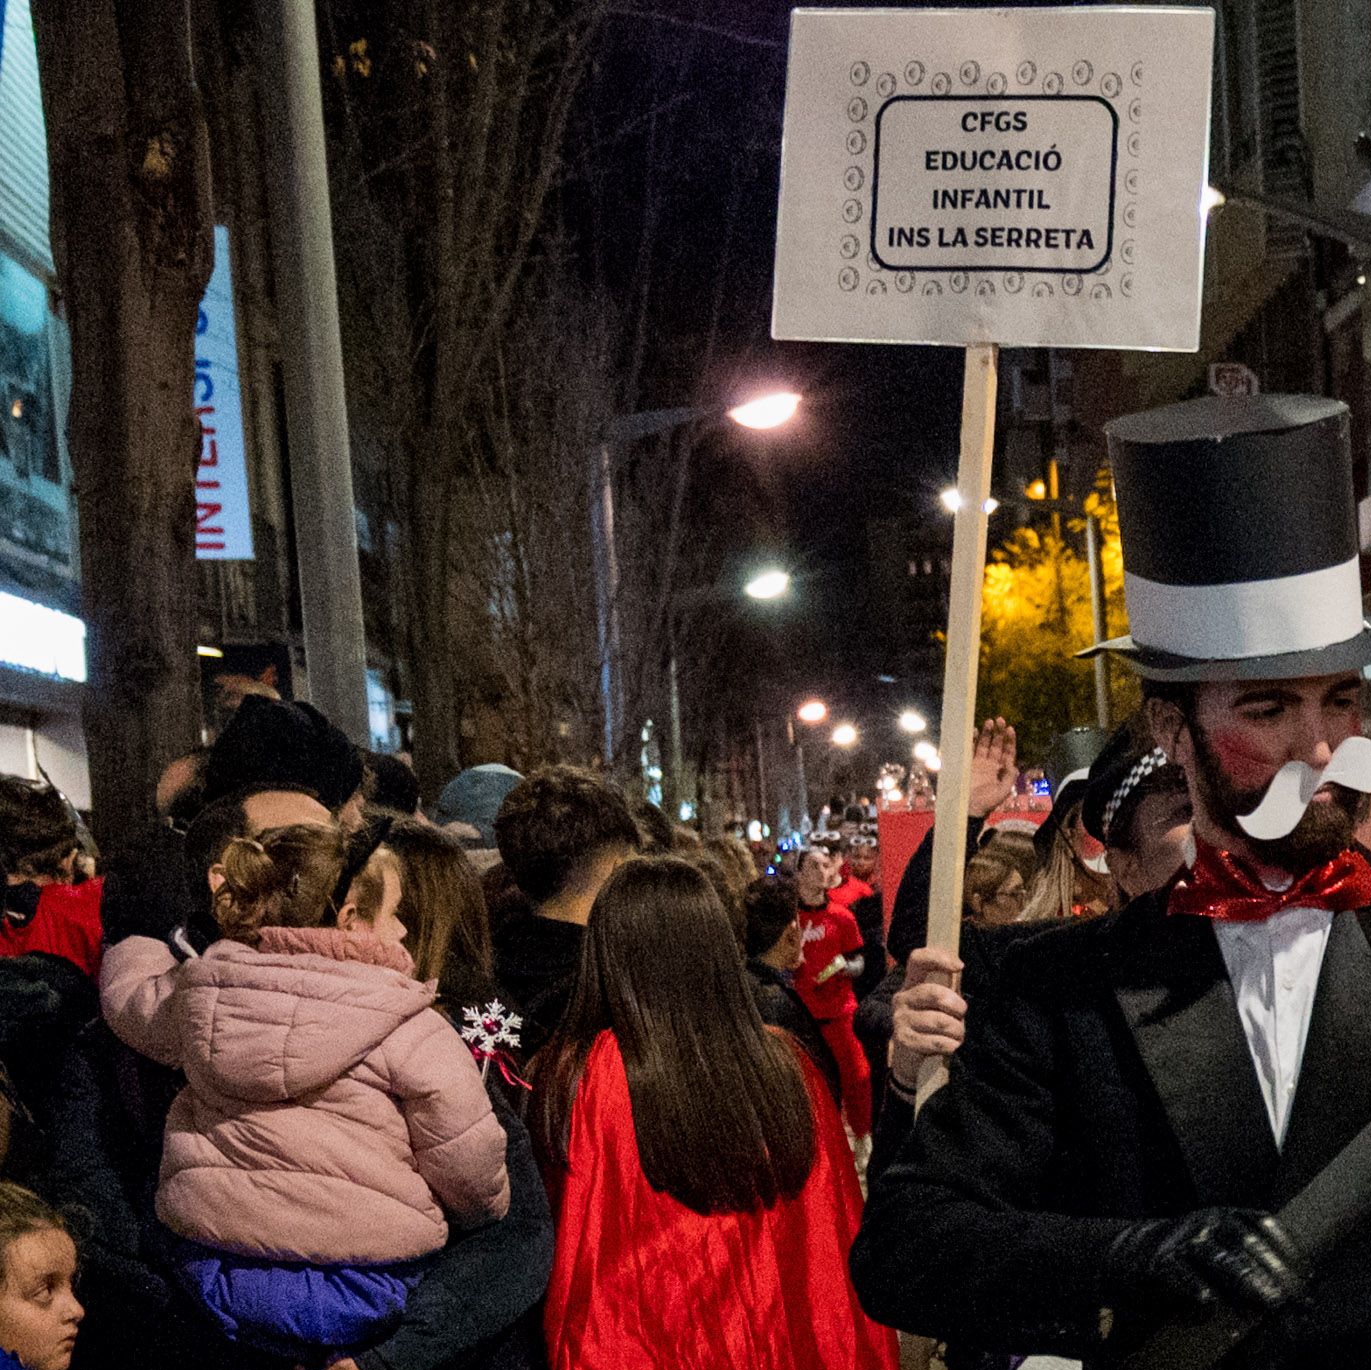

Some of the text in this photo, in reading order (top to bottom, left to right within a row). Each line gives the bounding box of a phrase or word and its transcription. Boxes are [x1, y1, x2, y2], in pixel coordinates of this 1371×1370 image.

[961, 111, 1028, 132] CFGS
[924, 144, 1063, 171] EDUCACIÓ
[932, 188, 1051, 210] INFANTIL
[887, 226, 1095, 250] INS LA SERRETA
